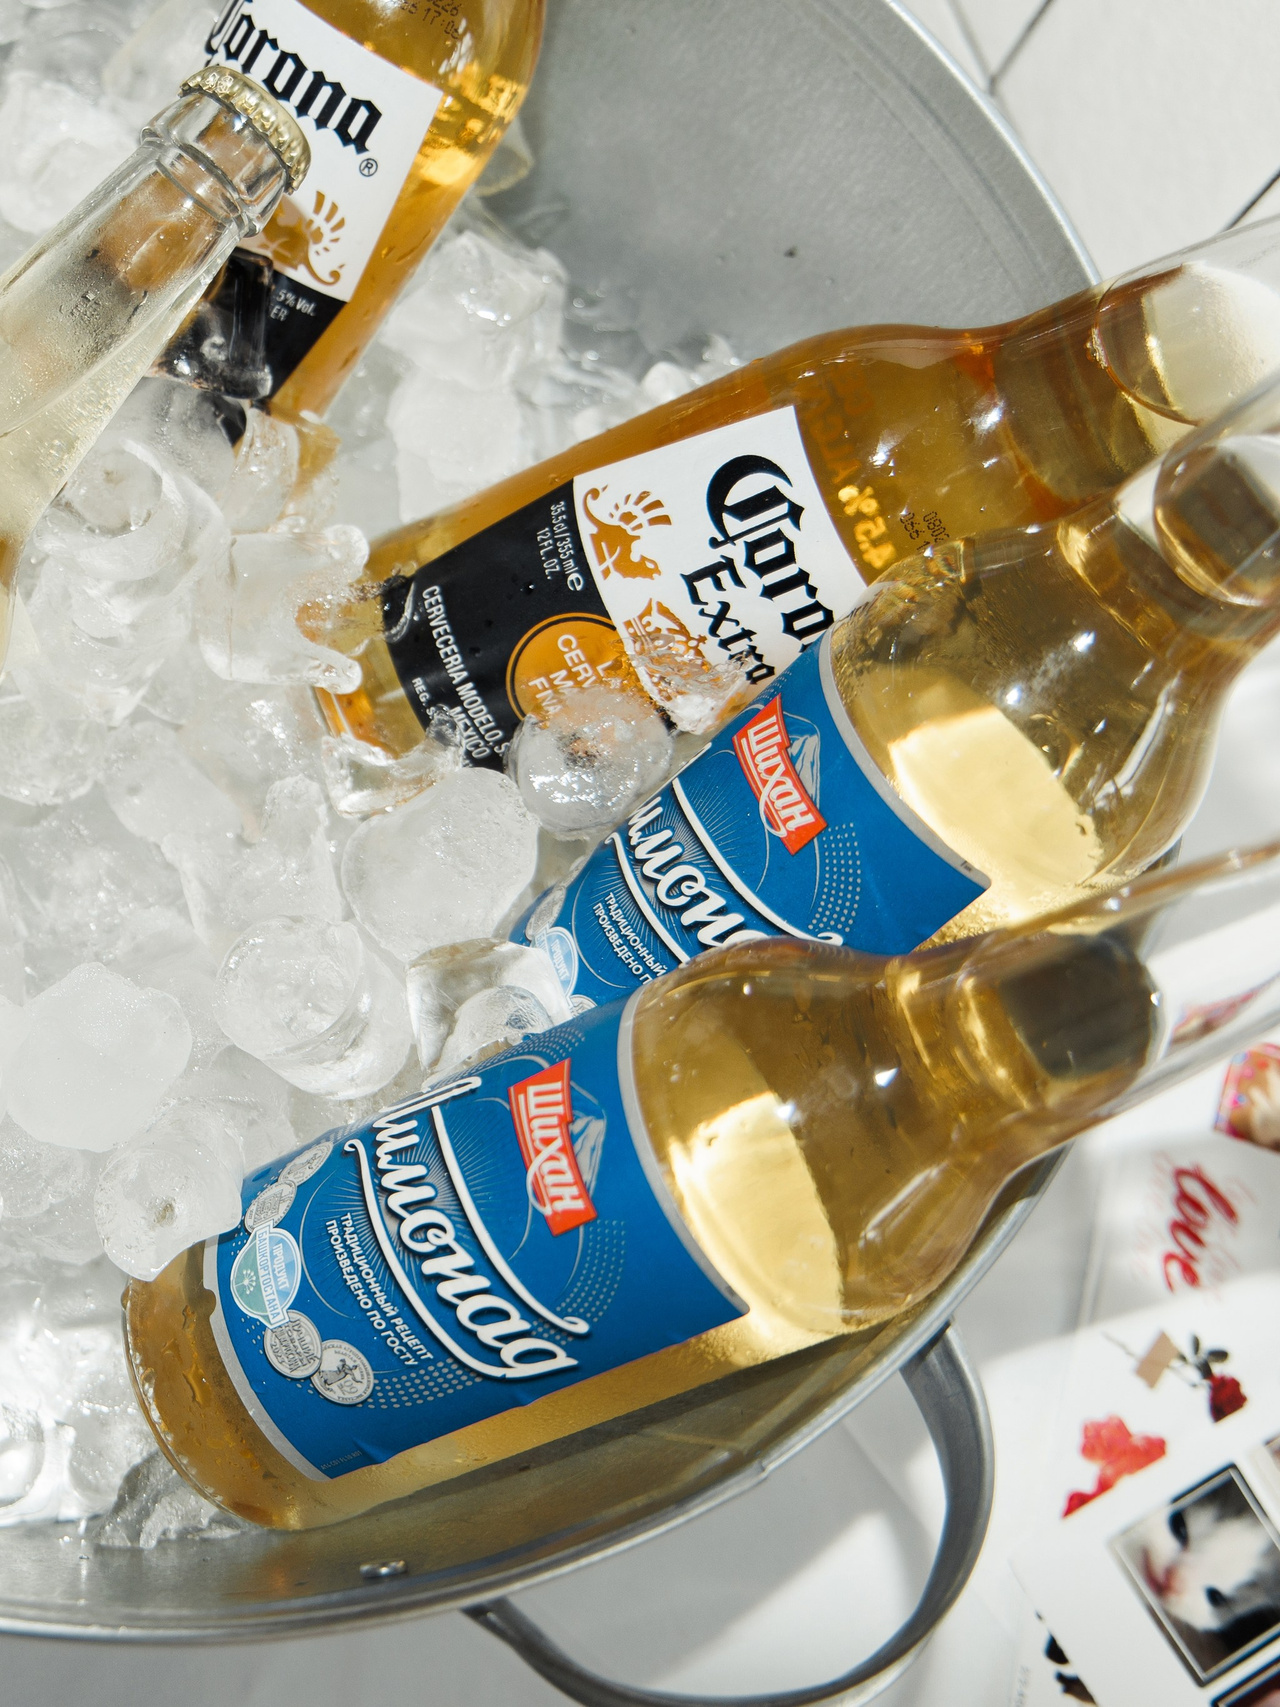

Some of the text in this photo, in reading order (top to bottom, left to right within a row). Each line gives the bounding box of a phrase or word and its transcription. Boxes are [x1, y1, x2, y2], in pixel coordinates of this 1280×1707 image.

[295, 297, 317, 317] Vol.
[706, 454, 835, 654] Coro
[412, 677, 430, 706] REG.
[422, 585, 468, 685] CERVECERIA
[456, 681, 504, 748] MODELO,
[557, 634, 596, 688] CERV
[742, 713, 817, 838] Шихан
[592, 901, 644, 976] ПРОИЗВЕДЕНО
[603, 891, 669, 978] ТРАДИЦИОННЫЙ
[524, 1080, 586, 1216] Шихан
[257, 1229, 282, 1321] БАШКОРТОСТАНА
[272, 1242, 290, 1291] ПРОДУКТ
[325, 1219, 373, 1310] ПРОИЗВЕДЕНО
[366, 1309, 387, 1330] ПО
[380, 1330, 419, 1366] ГОСТУ
[340, 1212, 400, 1318] ТРАДИЦИОННЫЙ
[390, 1316, 434, 1360] РЕЦЕПТ
